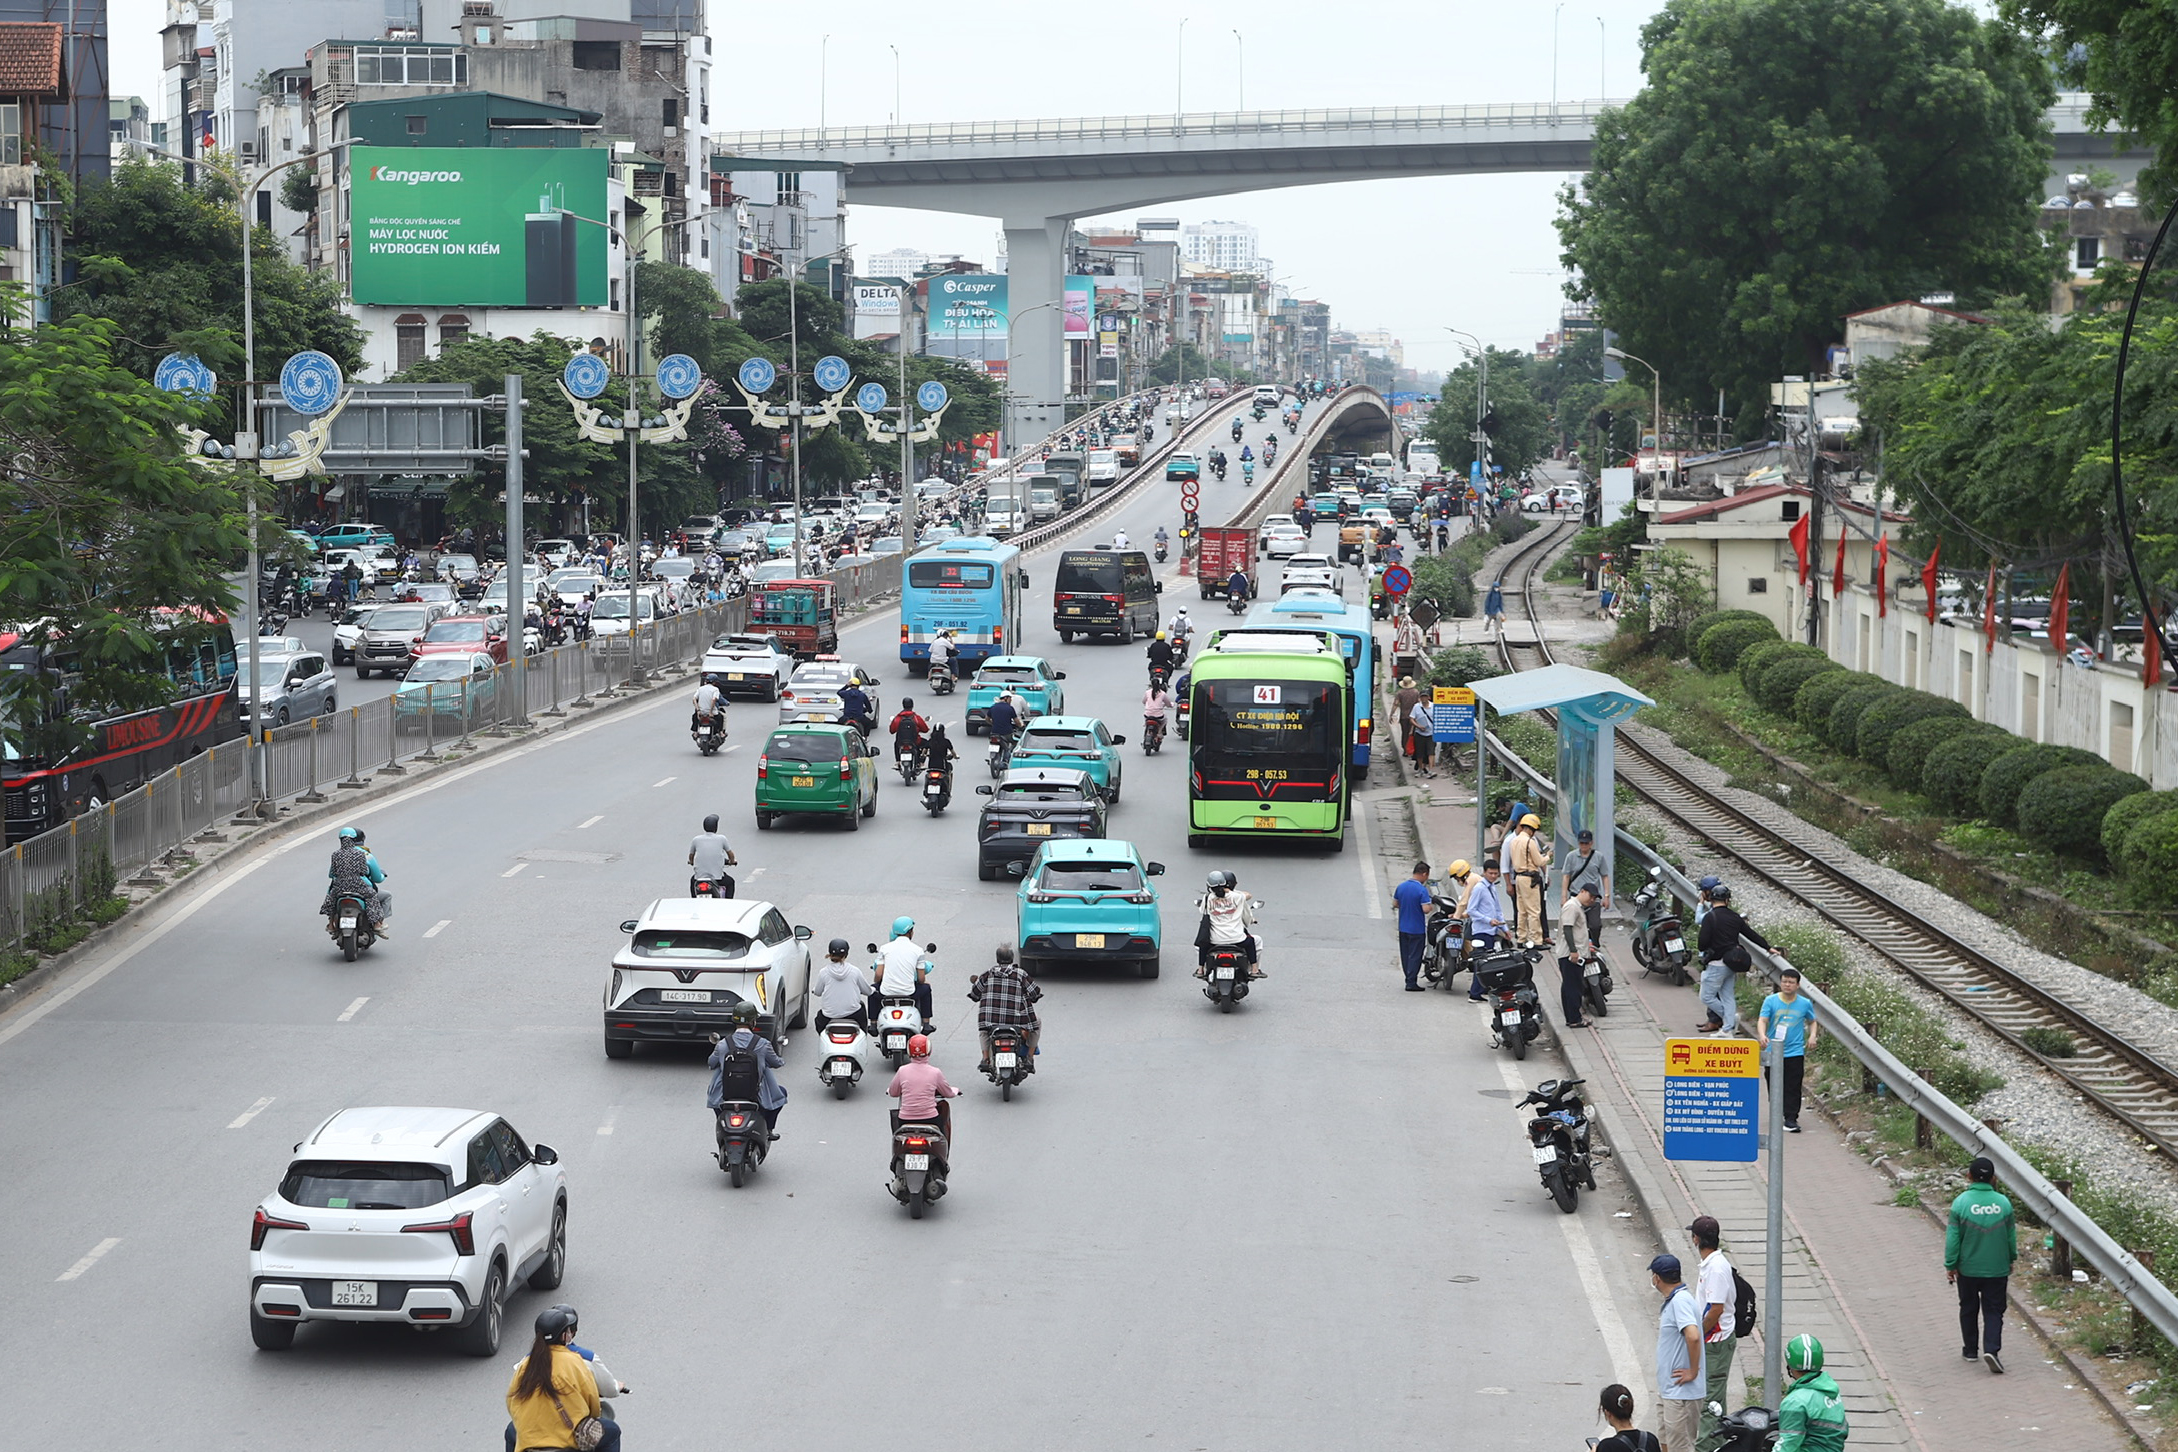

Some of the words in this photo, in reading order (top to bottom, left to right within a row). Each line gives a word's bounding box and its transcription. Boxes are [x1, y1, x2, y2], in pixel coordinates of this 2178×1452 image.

[370, 165, 461, 185] Kangaroo
[370, 227, 393, 239] MÁY
[396, 229, 416, 241] LỌC
[419, 228, 449, 239] NƯỚC
[370, 243, 439, 254] HYDROGEN
[443, 244, 465, 254] ION
[861, 288, 898, 298] DELTA
[957, 281, 996, 294] Casper
[861, 299, 899, 308] Windows
[974, 319, 998, 329] LAN
[946, 567, 958, 576] 32
[1257, 687, 1277, 701] 41
[1236, 711, 1247, 720] CT
[106, 714, 162, 750] LIMOUSINE
[1246, 769, 1259, 779] 29B
[1265, 769, 1287, 780] 057.53
[666, 992, 708, 1001] 14C-317.90
[1697, 1043, 1722, 1055] ĐIỂM
[1724, 1044, 1750, 1055] DỪNG
[1705, 1060, 1717, 1068] XE
[1719, 1057, 1743, 1068] BUÝT
[1970, 1202, 2002, 1216] Grab
[346, 1283, 365, 1293] 15K
[337, 1293, 373, 1305] 261.22
